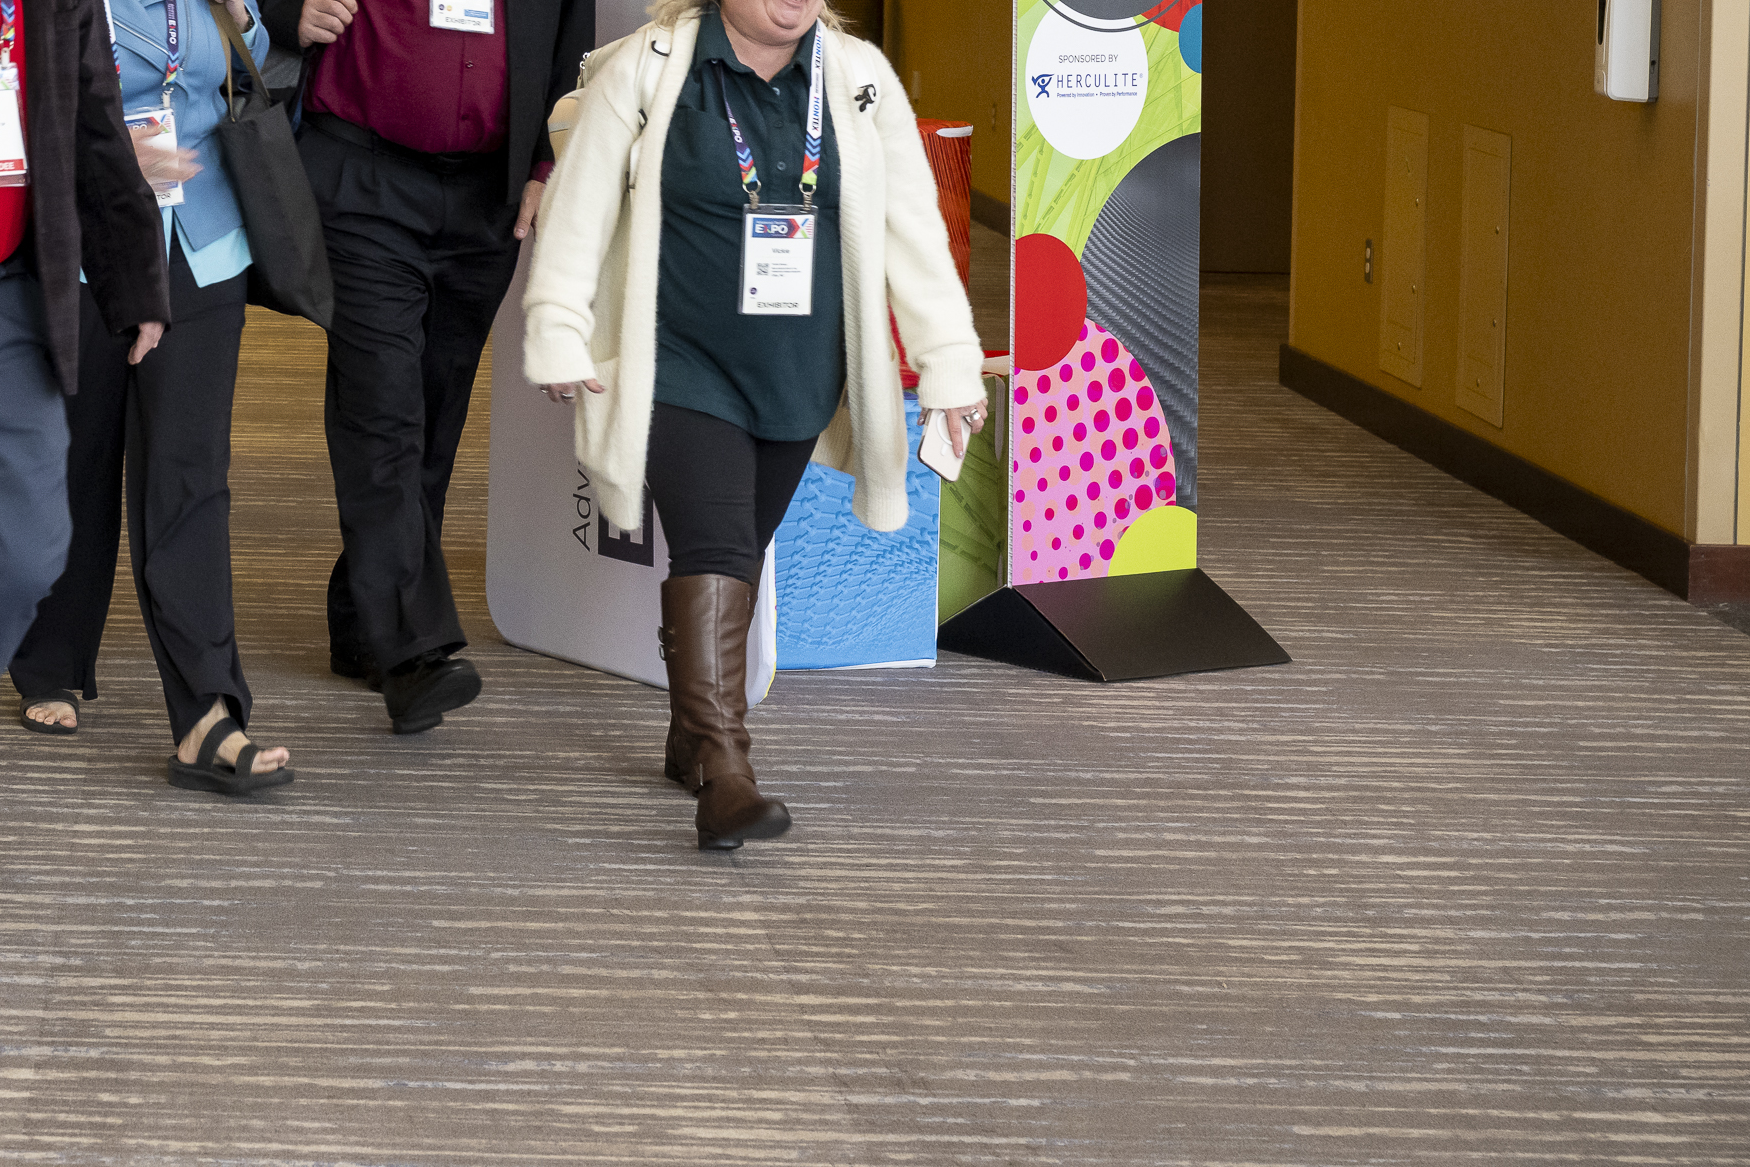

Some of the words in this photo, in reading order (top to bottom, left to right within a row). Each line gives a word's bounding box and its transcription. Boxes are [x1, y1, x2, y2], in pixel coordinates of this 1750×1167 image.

[168, 20, 177, 45] EXPO
[1058, 54, 1106, 63] SPONSORED
[1108, 54, 1118, 63] BY
[729, 118, 743, 143] EXPO
[755, 224, 788, 234] EXPO
[573, 460, 591, 552] Adv
